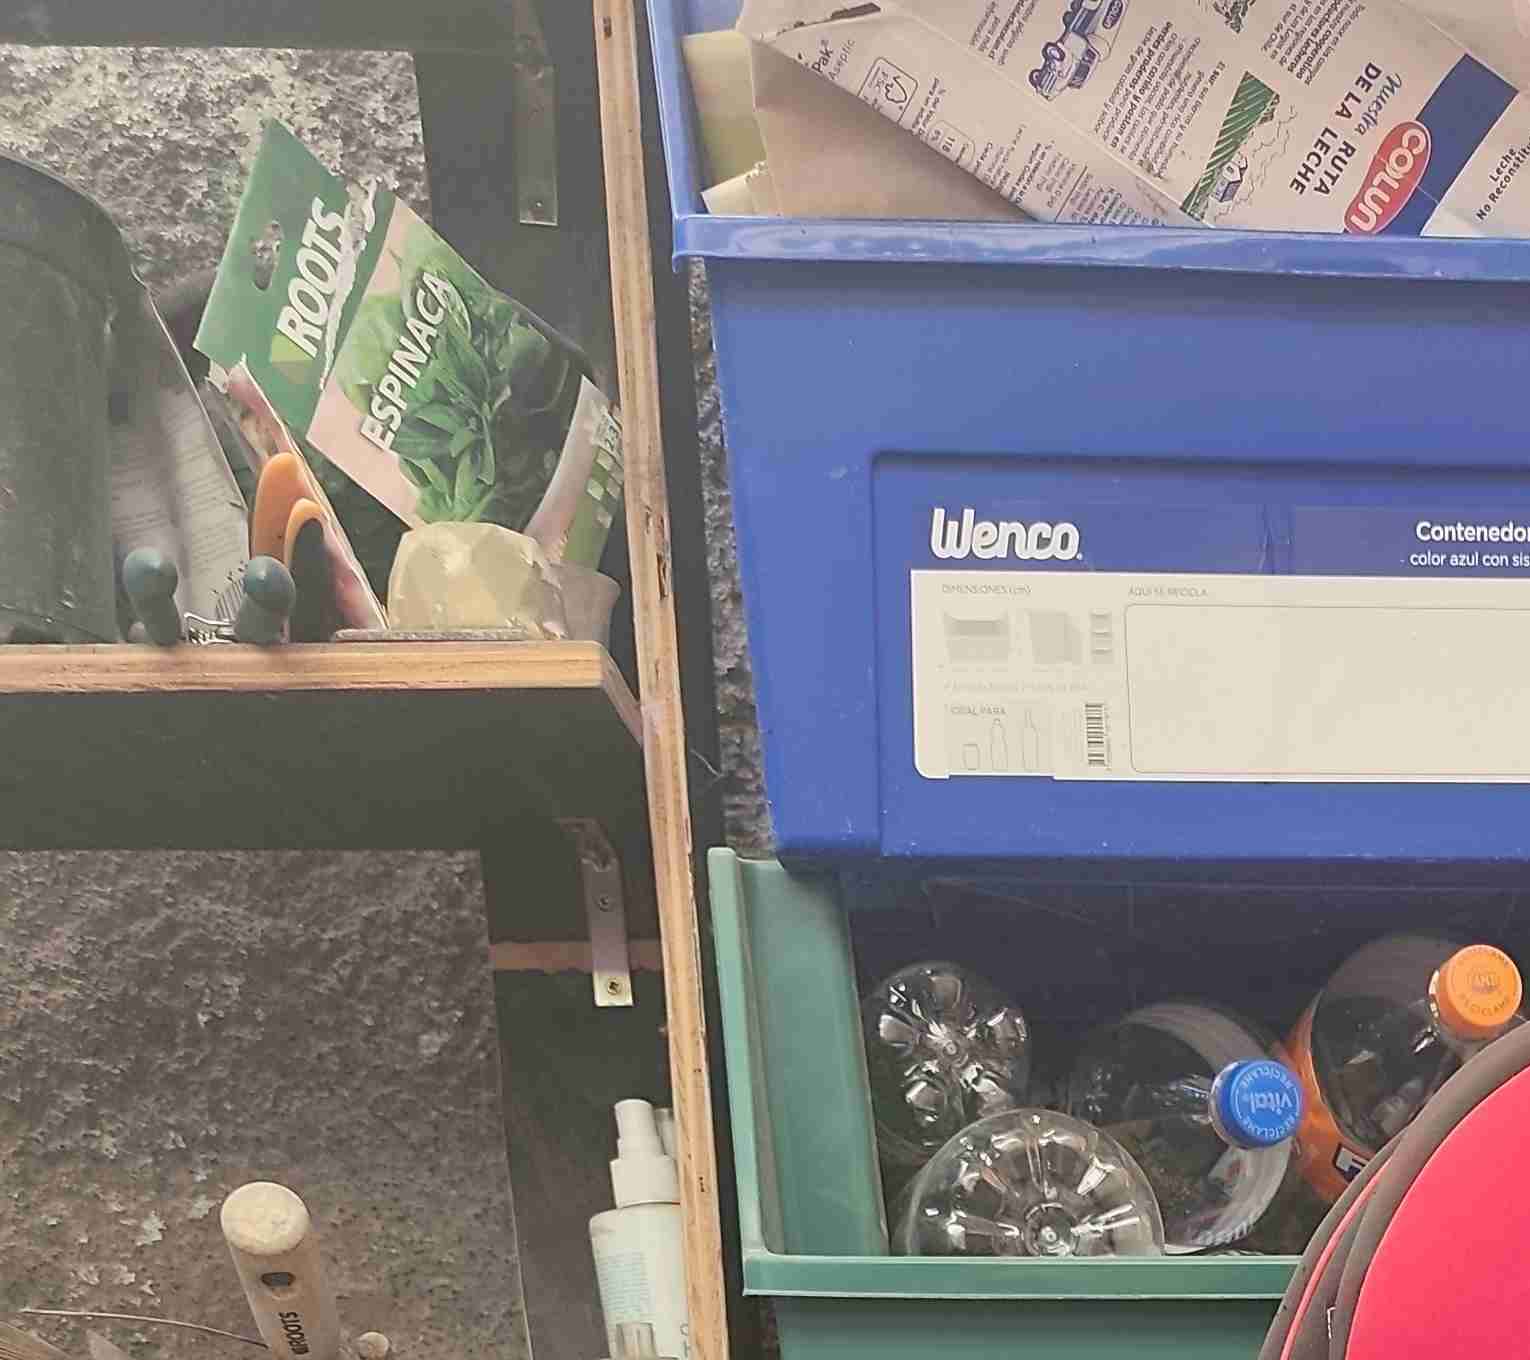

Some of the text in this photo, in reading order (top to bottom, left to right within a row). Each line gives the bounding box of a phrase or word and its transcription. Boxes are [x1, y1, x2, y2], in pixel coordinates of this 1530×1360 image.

[1289, 62, 1382, 195] DE LA LECHE
[1313, 140, 1357, 195] RUTA
[1351, 128, 1427, 229] COLUN
[1490, 148, 1516, 182] Leche
[1476, 203, 1492, 219] No
[276, 197, 350, 358] ROOTS
[358, 273, 450, 452] ESPINACA
[930, 507, 1080, 560] Wenco
[1410, 551, 1446, 567] color
[1450, 552, 1479, 567] azul
[1483, 555, 1509, 568] con
